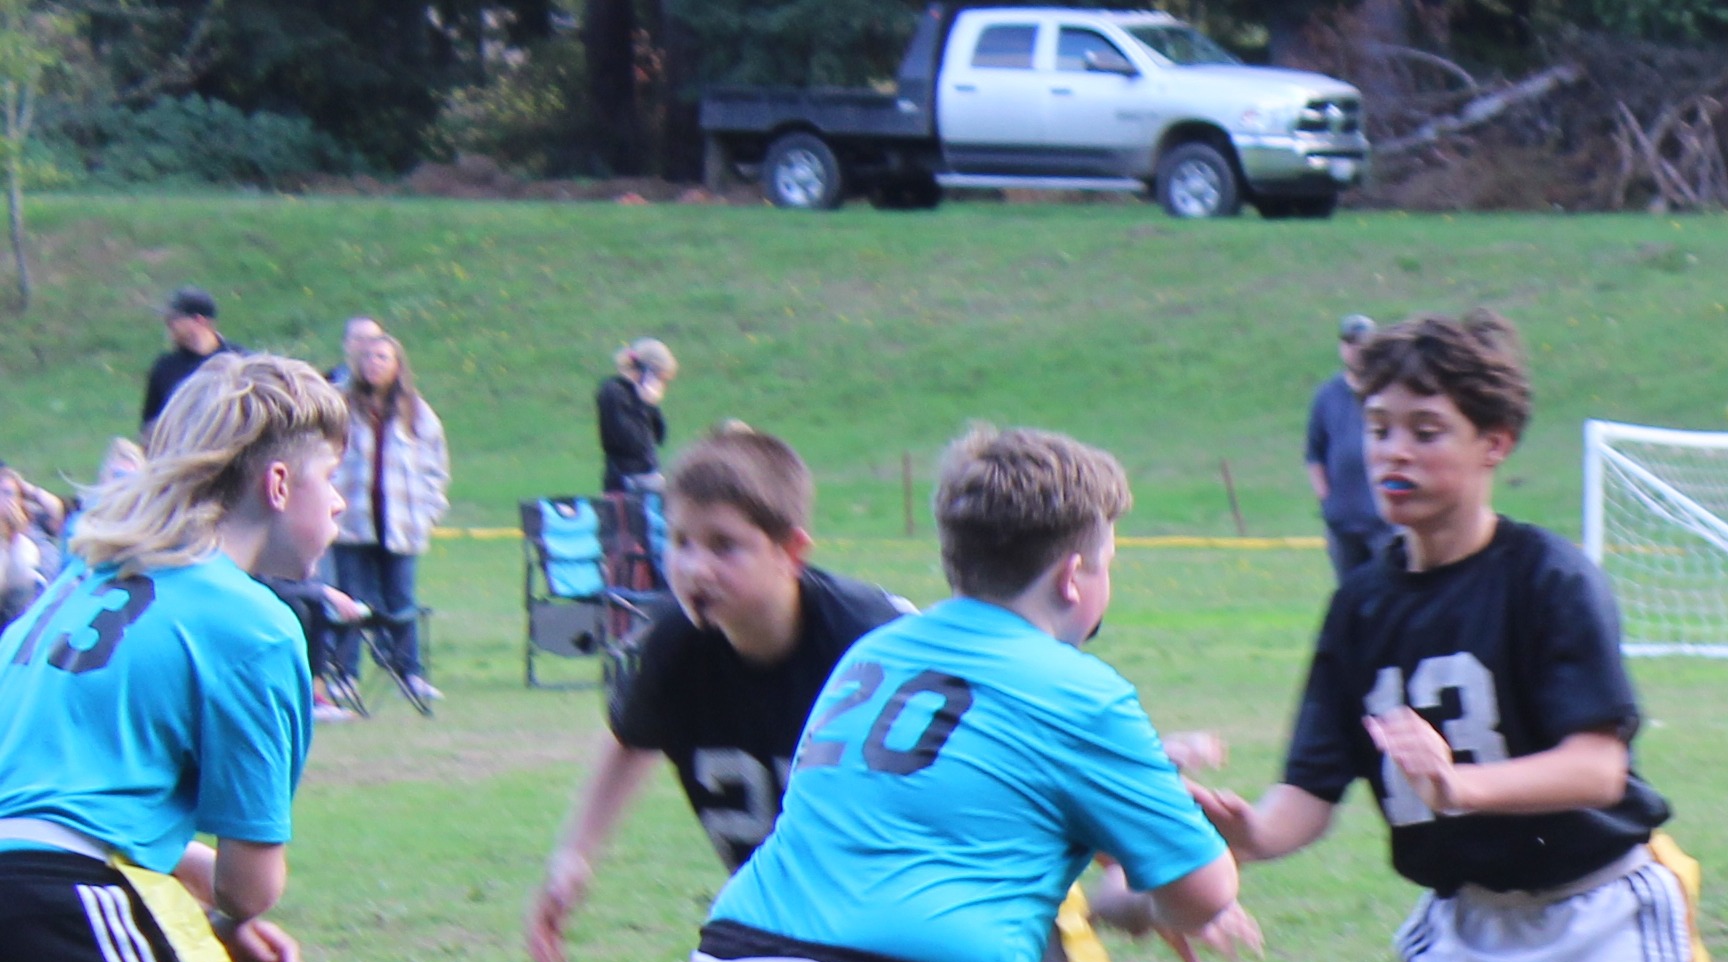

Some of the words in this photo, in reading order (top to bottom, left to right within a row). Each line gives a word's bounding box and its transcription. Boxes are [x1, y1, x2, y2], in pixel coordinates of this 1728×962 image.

[12, 572, 156, 675] 13
[798, 662, 974, 777] 20
[1363, 651, 1510, 826] 13
[694, 746, 794, 876] 2
